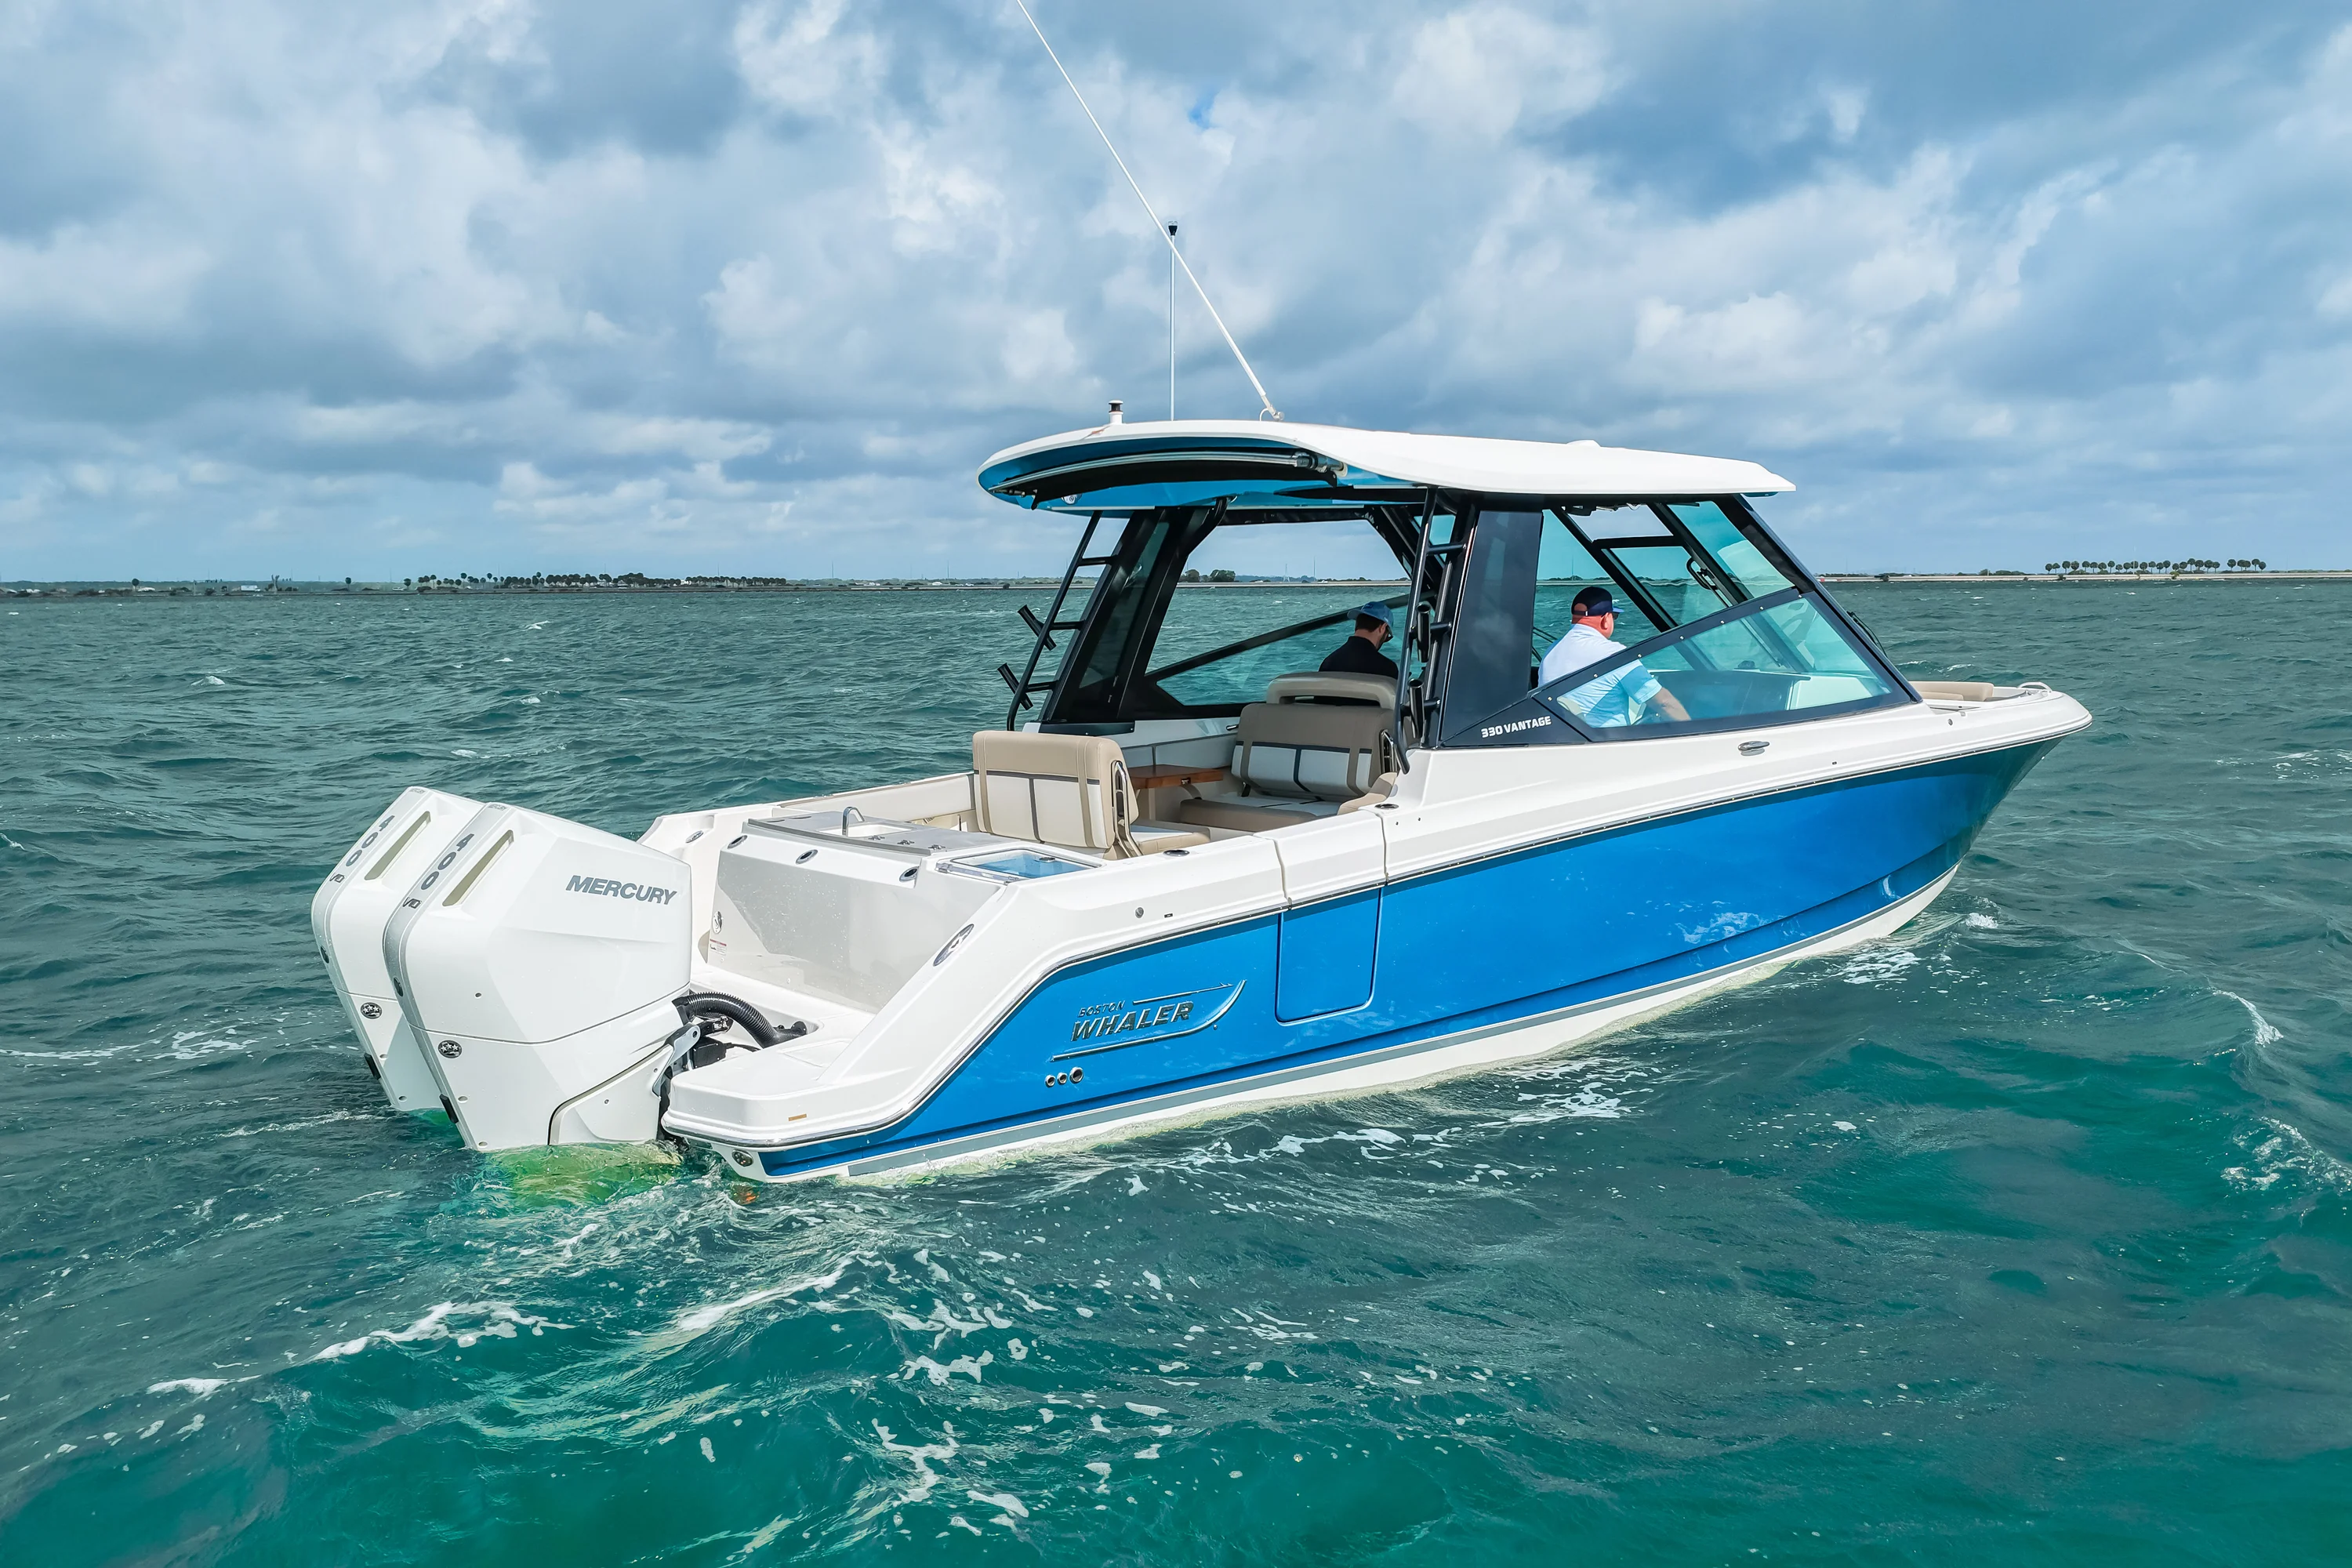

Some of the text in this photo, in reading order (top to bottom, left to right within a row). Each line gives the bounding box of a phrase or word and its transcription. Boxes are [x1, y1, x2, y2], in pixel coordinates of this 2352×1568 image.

[1481, 716, 1552, 738] 330 VANTAGE
[345, 815, 395, 867] 400
[420, 833, 474, 891] 400
[565, 875, 677, 905] MERCURY
[1070, 1000, 1194, 1041] WHALER
[1077, 1000, 1126, 1018] BOSTON
